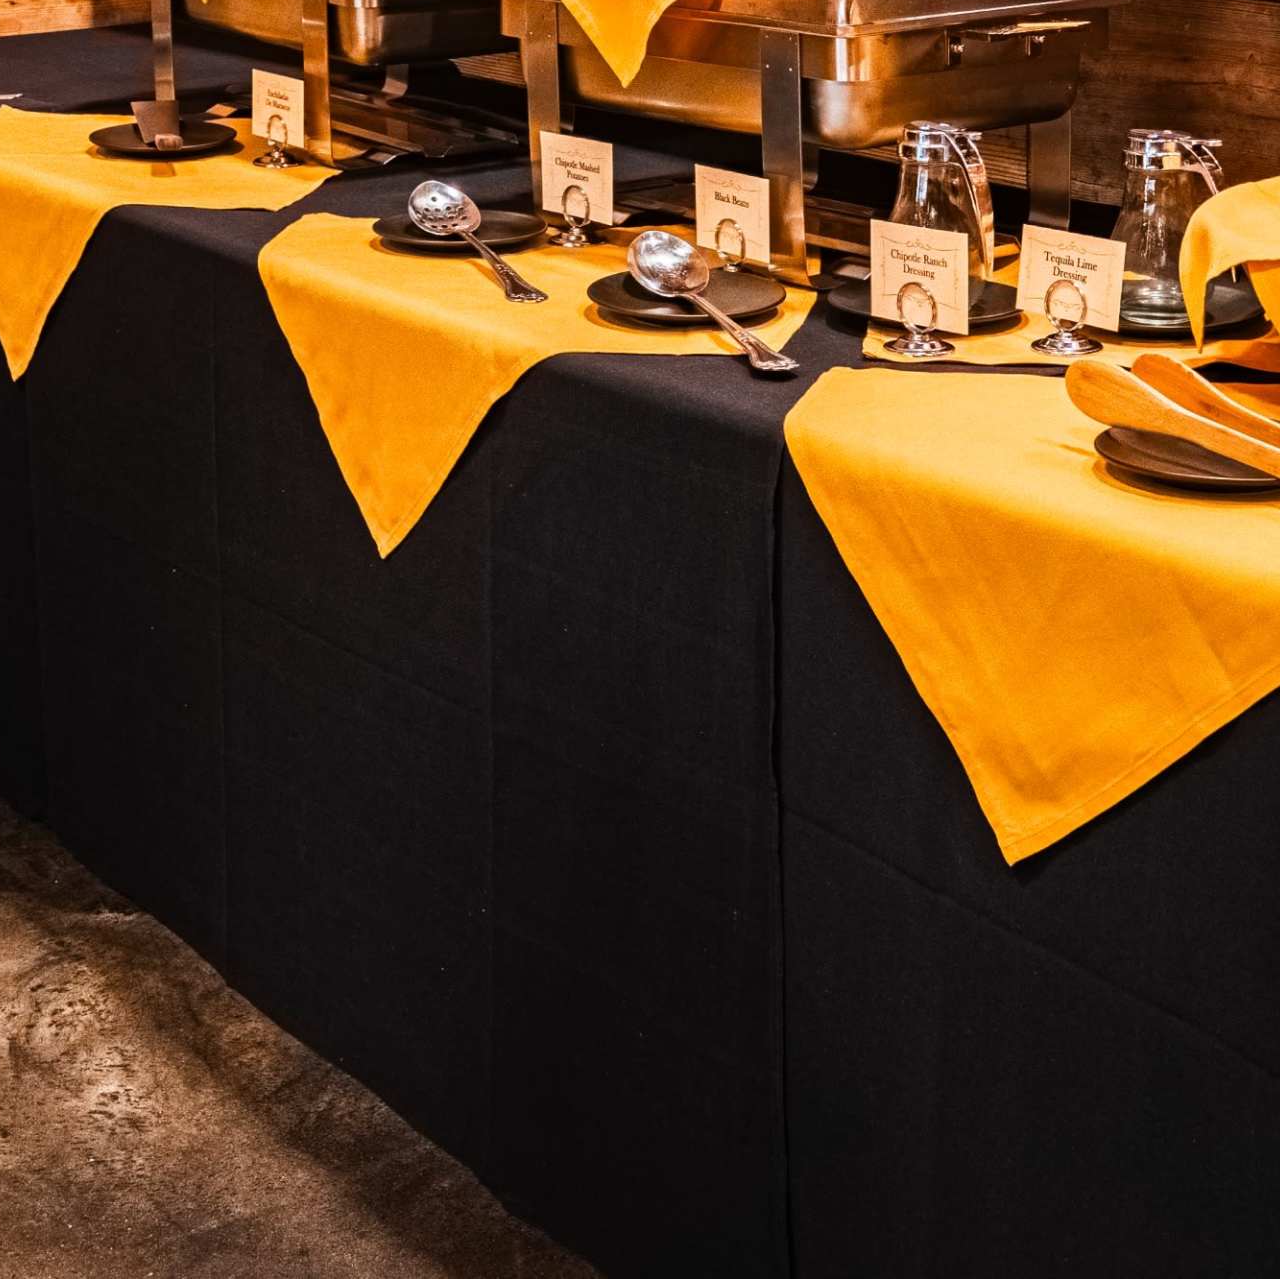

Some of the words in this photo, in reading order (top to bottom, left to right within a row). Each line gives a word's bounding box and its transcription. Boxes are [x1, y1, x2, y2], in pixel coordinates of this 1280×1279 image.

[554, 156, 578, 169] Chipotle
[579, 160, 601, 174] Mashed
[714, 191, 731, 204] Black
[732, 195, 750, 209] Beans
[890, 248, 922, 264] Chipotle
[923, 254, 948, 269] Ranch
[1044, 250, 1075, 267] Tequila
[1076, 257, 1098, 272] Lime
[903, 263, 936, 281] Dressing
[1052, 266, 1088, 284] Dressing
